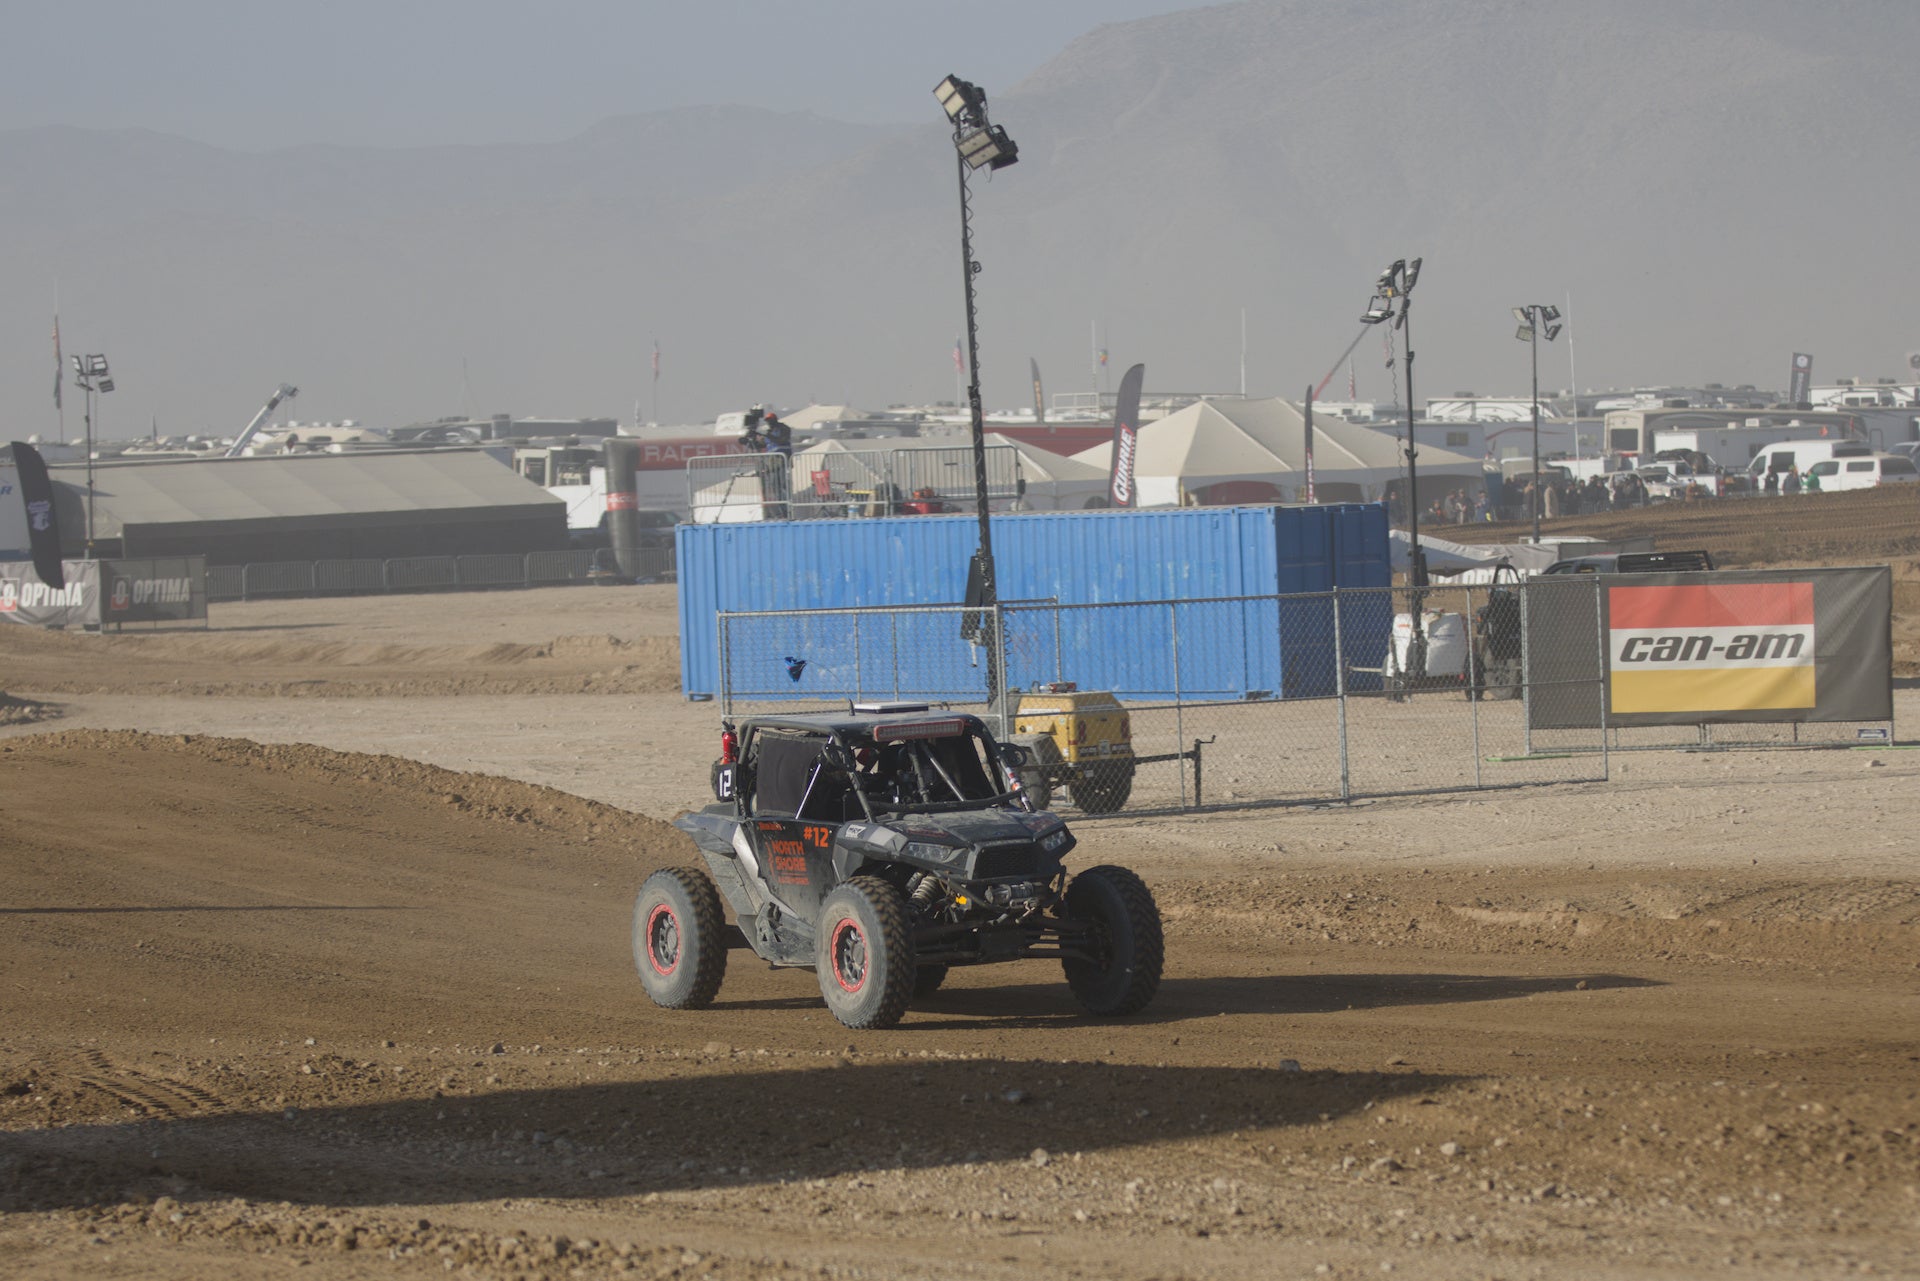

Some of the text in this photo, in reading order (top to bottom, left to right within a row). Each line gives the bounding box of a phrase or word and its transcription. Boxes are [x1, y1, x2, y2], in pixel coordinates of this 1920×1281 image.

[1113, 427, 1133, 502] CURRIE
[133, 578, 190, 604] OPTIMA
[1620, 633, 1805, 662] can-am
[719, 769, 732, 797] 12
[772, 840, 805, 855] NORTH
[803, 826, 829, 847] #12
[776, 856, 807, 872] SHORE
